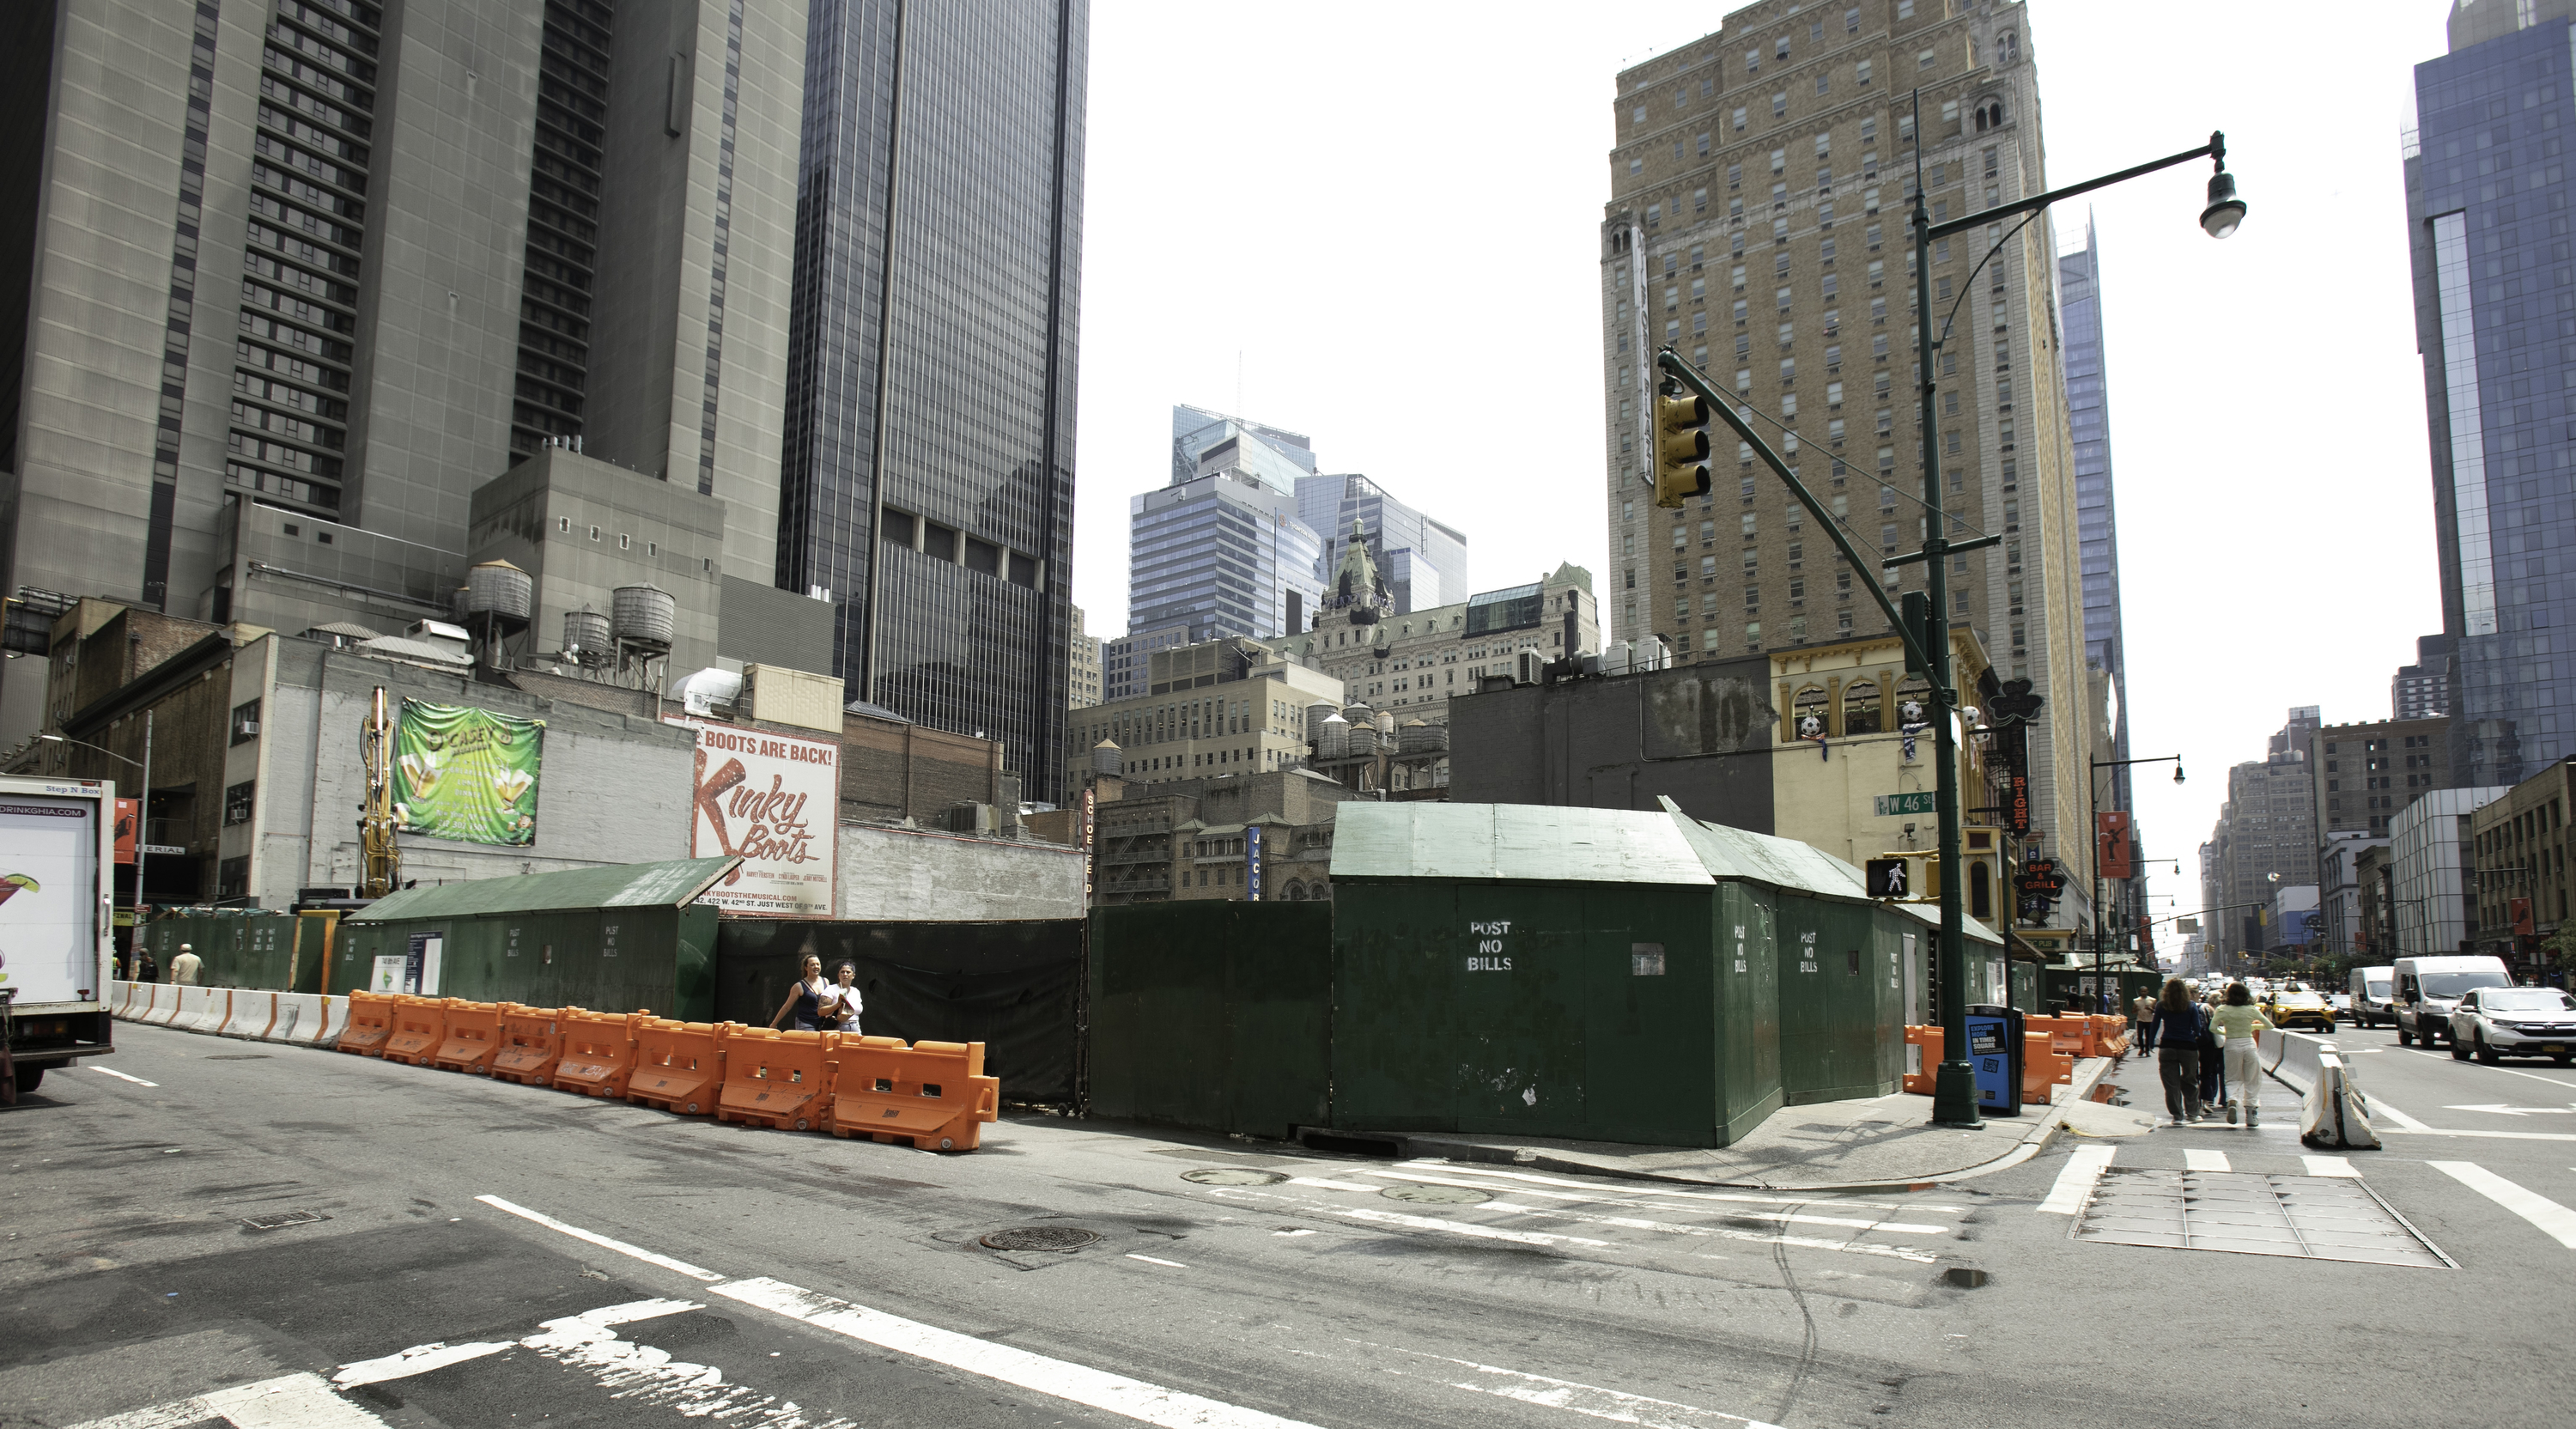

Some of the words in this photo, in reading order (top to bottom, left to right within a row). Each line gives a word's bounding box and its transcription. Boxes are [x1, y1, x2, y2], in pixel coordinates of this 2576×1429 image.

[705, 730, 756, 754] BOOTS
[759, 739, 787, 758] ARE
[790, 745, 832, 765] BACK!
[2012, 725, 2028, 829] PLAYWRIGHT
[46, 785, 67, 794] Step
[455, 789, 482, 799] DINNER
[1889, 797, 1899, 812] W
[1904, 796, 1920, 811] 46
[1923, 794, 1931, 804] St
[0, 806, 81, 816] DRINKGHIA.COM
[738, 824, 820, 864] Boots
[2029, 863, 2052, 873] BAR
[2025, 880, 2057, 890] GRILL
[509, 928, 520, 937] POST
[605, 926, 619, 934] POST
[1470, 921, 1511, 935] POST
[1735, 925, 1745, 939] POST
[1801, 932, 1816, 944] POST
[1479, 939, 1503, 953] NO
[1737, 943, 1743, 956] NO
[1804, 946, 1814, 958] NO
[603, 948, 617, 957] BILLS
[1467, 957, 1512, 971] BILLS
[1735, 959, 1747, 973] BILLS
[1800, 961, 1818, 973] BILLS
[1892, 965, 1897, 975] NO
